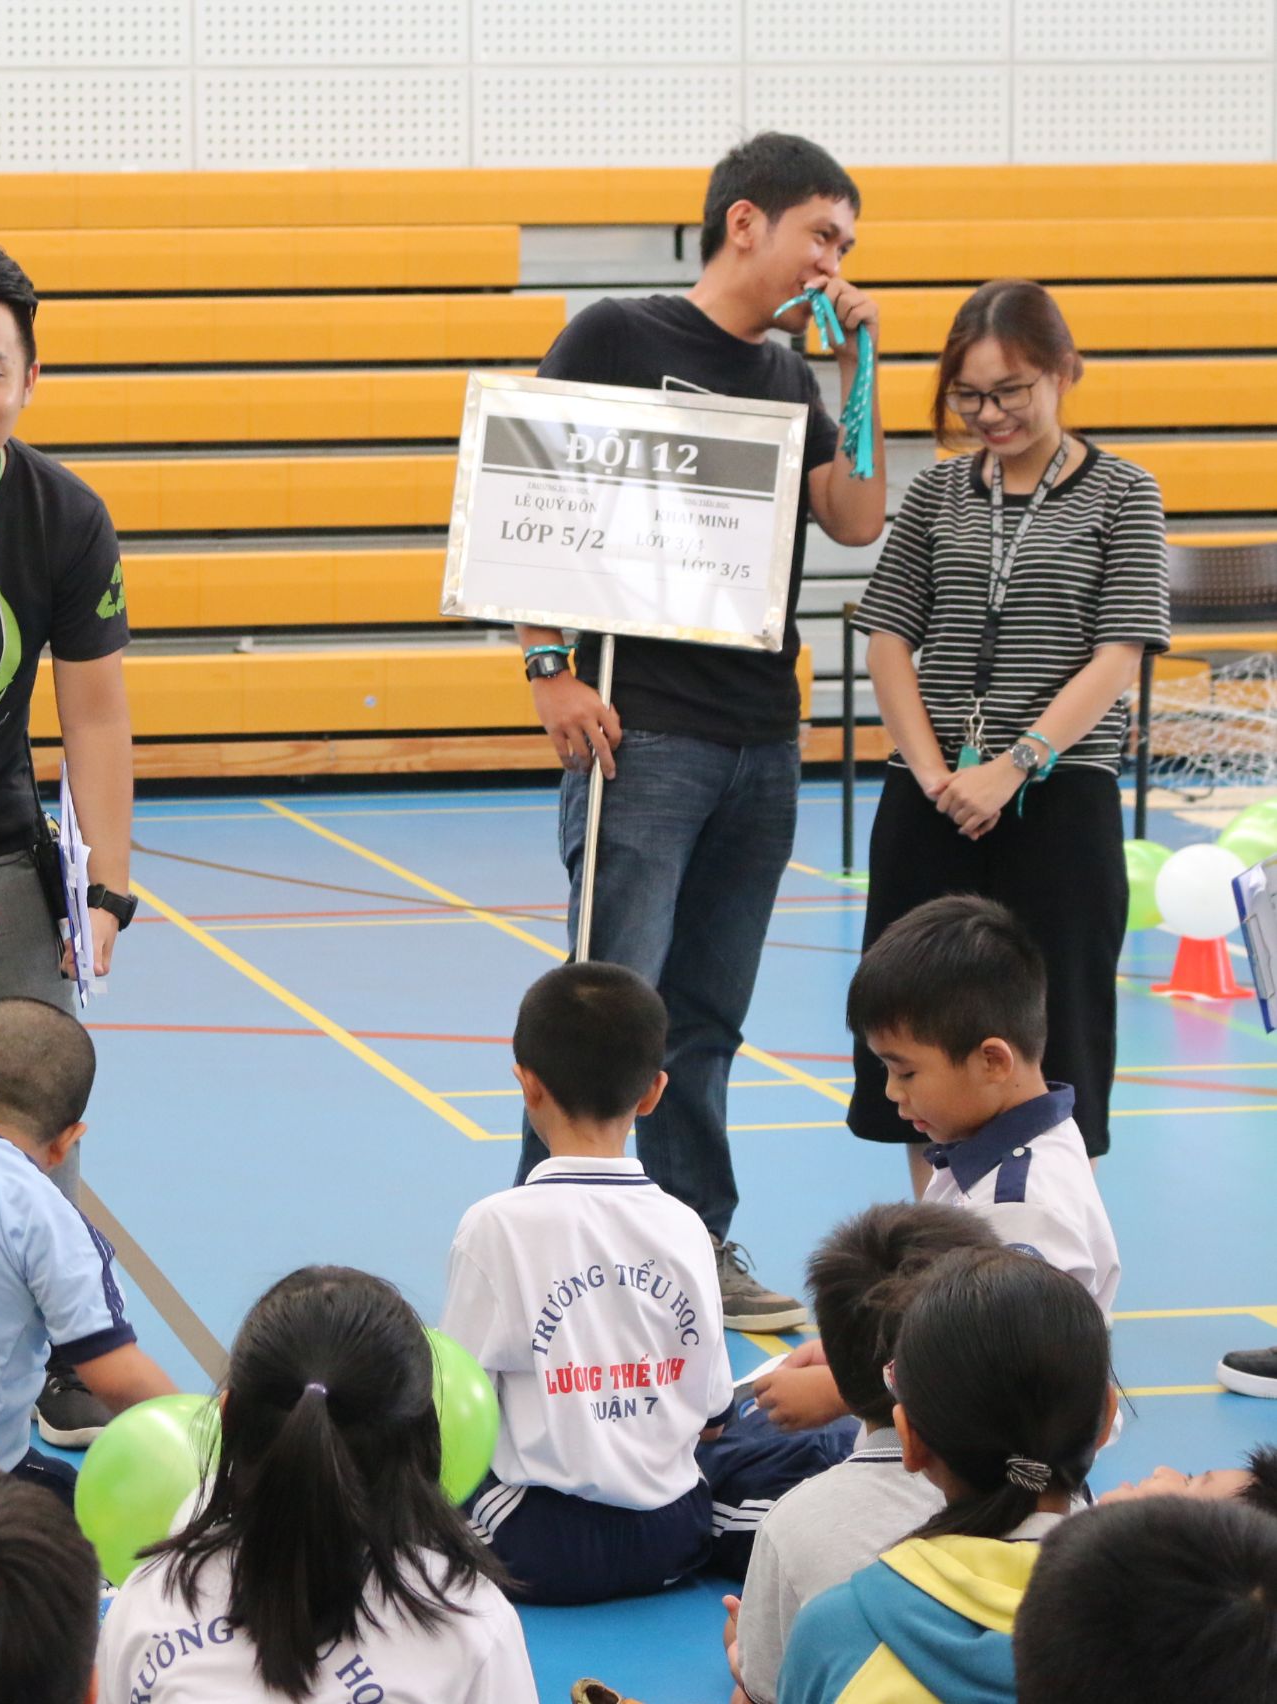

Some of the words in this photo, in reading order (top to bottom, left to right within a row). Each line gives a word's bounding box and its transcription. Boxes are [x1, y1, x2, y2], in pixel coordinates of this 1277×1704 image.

[565, 427, 642, 475] ĐỘI
[651, 442, 699, 476] 12
[500, 516, 554, 545] LỚP
[561, 525, 605, 553] 5/2
[697, 513, 740, 530] MINH
[719, 562, 751, 581] 3/5
[532, 1264, 605, 1356] TRƯỜNG
[615, 1259, 672, 1299] TIỂU
[670, 1290, 700, 1347] HỌC
[610, 1353, 651, 1390] THẾ
[644, 1397, 659, 1415] 7
[130, 1615, 235, 1704] RƯỜNG
[333, 1653, 385, 1704] HỌ
